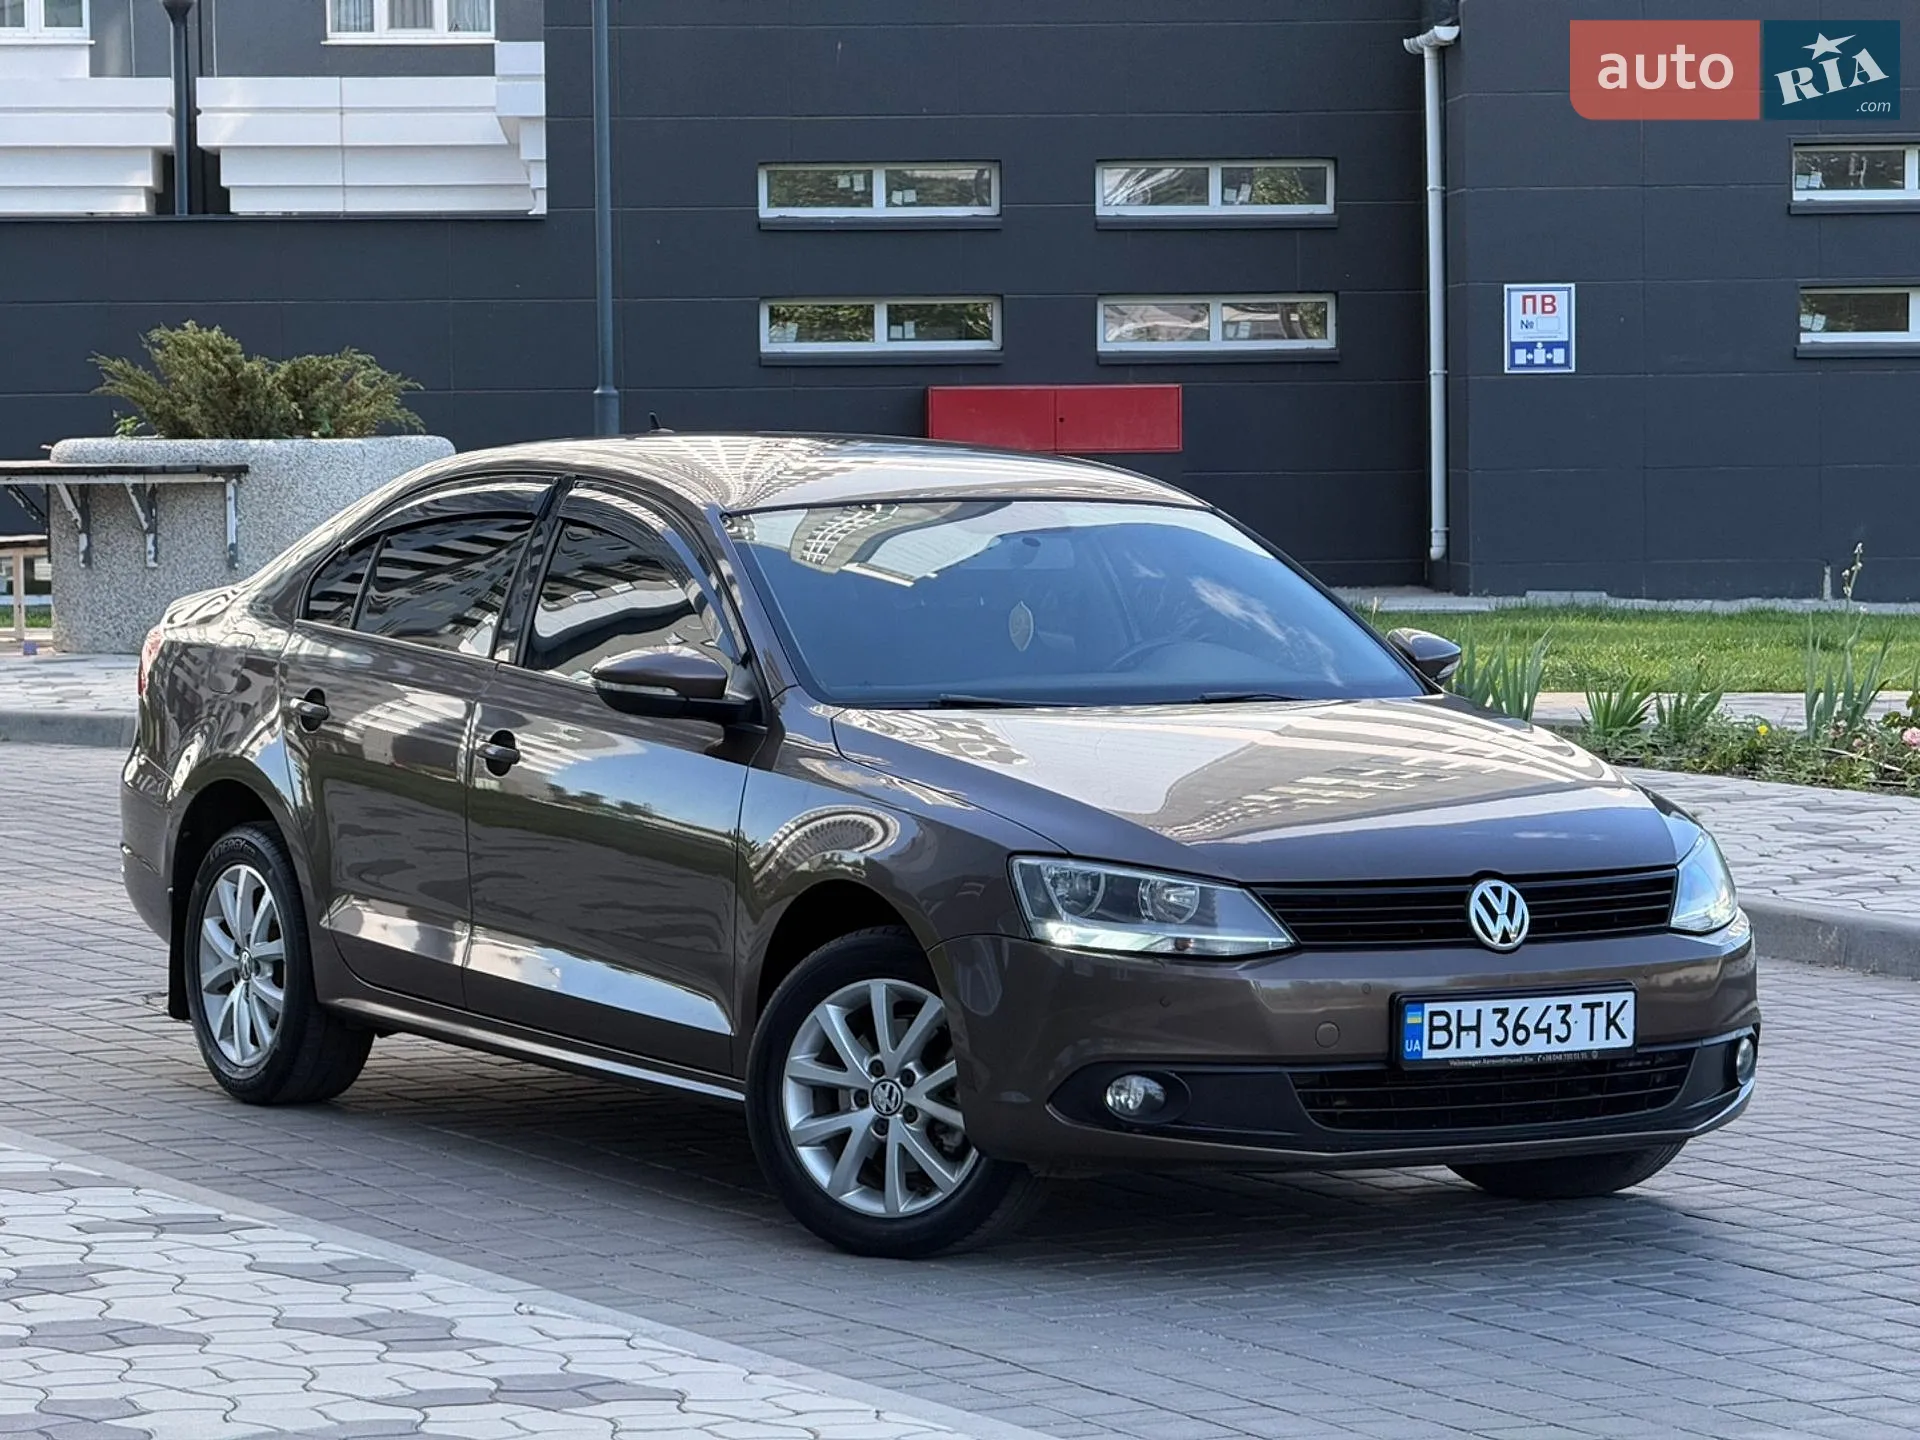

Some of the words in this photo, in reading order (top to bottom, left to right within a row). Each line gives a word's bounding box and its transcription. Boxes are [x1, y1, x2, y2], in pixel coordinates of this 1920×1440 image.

[1521, 294, 1557, 315] ПВ
[1427, 1008, 1482, 1050] BH
[1490, 1003, 1572, 1047] 3643
[1581, 1000, 1629, 1041] TK
[1405, 1040, 1421, 1052] UA
